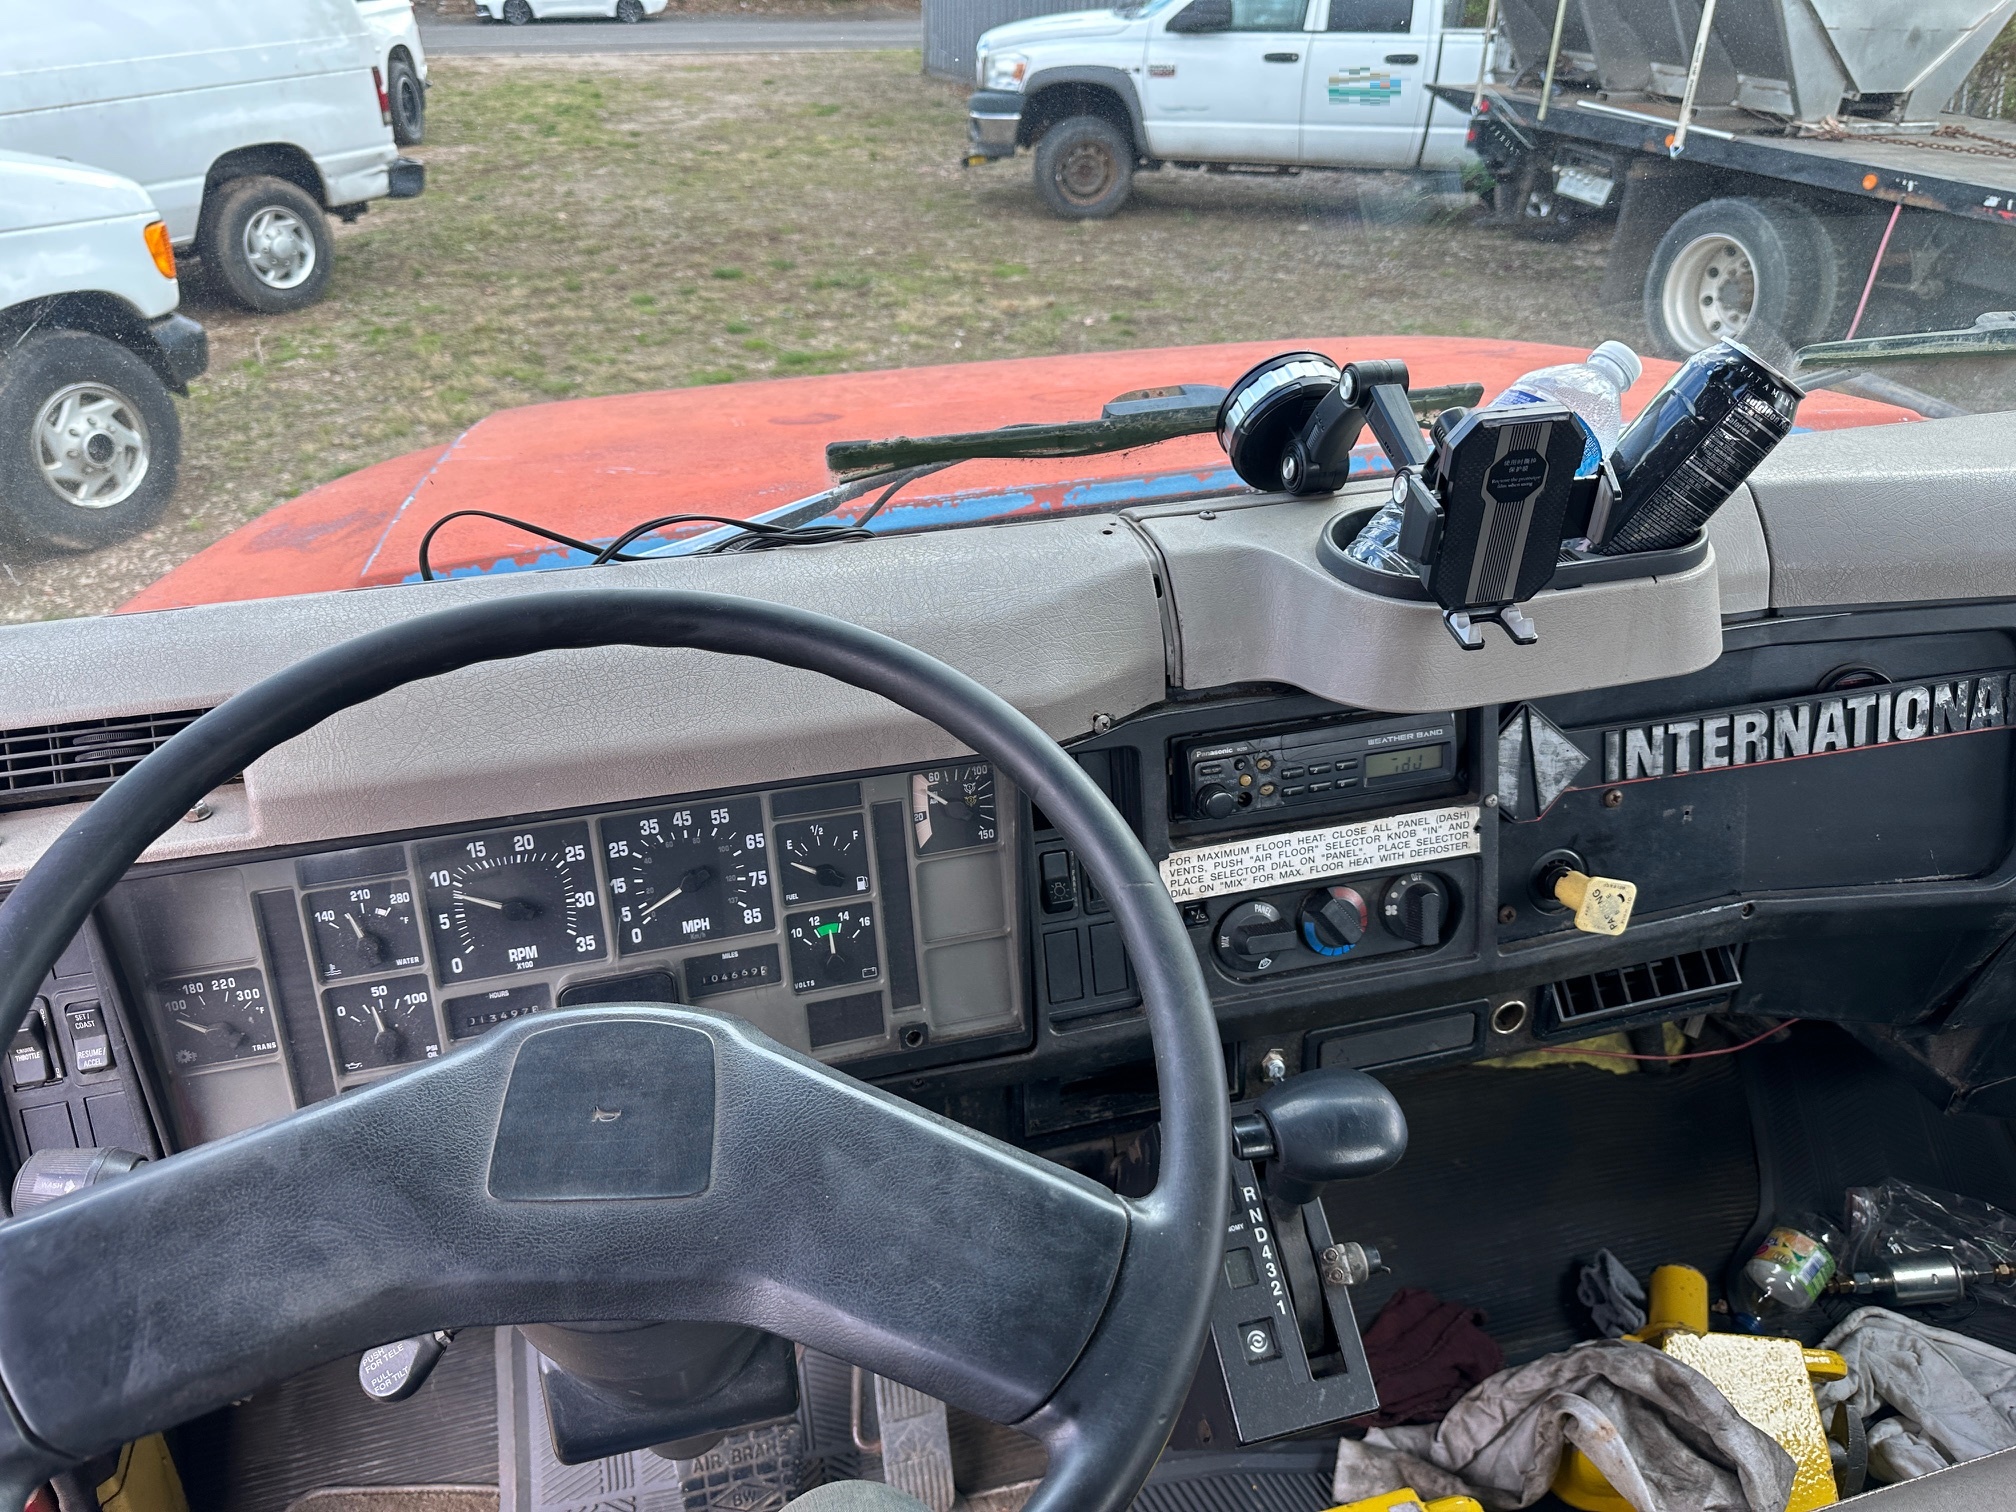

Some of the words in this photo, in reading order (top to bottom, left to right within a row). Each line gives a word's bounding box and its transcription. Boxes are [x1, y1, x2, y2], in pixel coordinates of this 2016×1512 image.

[1740, 365, 1794, 410] VITAMINS
[1742, 392, 1780, 424] Nutrition
[1725, 413, 1751, 436] Calories
[1367, 733, 1414, 745] WEATHER
[1416, 729, 1443, 739] BAND
[1196, 747, 1233, 757] Panasonic
[928, 771, 940, 782] 60
[972, 765, 988, 775] 100
[673, 810, 692, 827] 45
[710, 808, 730, 825] 55
[913, 813, 924, 822] 20
[639, 818, 659, 836] 35
[852, 830, 859, 840] F
[978, 829, 995, 840] 150
[513, 834, 535, 852] 20
[745, 833, 765, 849] 65
[786, 839, 793, 850] E
[1169, 856, 1191, 867] FOR
[1197, 846, 1250, 863] MAXIMUM
[1256, 839, 1291, 853] FLOOR
[1297, 834, 1326, 845] HEAT:
[1332, 827, 1367, 840] CLOSE
[1372, 823, 1392, 833] ALL
[1397, 817, 1430, 829] PANEL
[1435, 811, 1470, 825] (DASH)
[1213, 858, 1243, 870] PUSH
[1249, 851, 1275, 864] "AIR
[1278, 845, 1319, 859] FLOOR"
[1325, 835, 1381, 851] SELECTOR
[1387, 829, 1417, 841] KNOB
[1422, 825, 1443, 835] "IN"
[1448, 820, 1470, 831] AND
[466, 841, 486, 859] 15
[565, 845, 586, 862] 25
[608, 841, 629, 859] 25
[1170, 874, 1204, 888] PLACE
[1210, 864, 1265, 881] SELECTOR
[1271, 858, 1295, 871] DIAL
[1300, 856, 1315, 865] ON
[1377, 840, 1411, 853] PLACE
[1416, 831, 1469, 847] SELECTOR
[1170, 885, 1194, 898] DIAL
[1199, 884, 1214, 893] ON
[1219, 878, 1247, 889] "MIX"
[1252, 873, 1274, 884] FOR
[1279, 868, 1304, 880] MAX.
[1309, 858, 1344, 874] FLOOR
[1349, 855, 1375, 868] HEAT
[1379, 850, 1404, 863] WITH
[1409, 841, 1471, 858] DEFROSTER.
[1410, 873, 1423, 881] OFF
[429, 870, 450, 888] 10
[610, 877, 627, 894] 15
[748, 870, 768, 887] 75
[349, 888, 371, 901] 210
[389, 892, 410, 905] 280
[574, 891, 595, 908] 30
[785, 893, 799, 901] FUEL
[314, 910, 335, 922] 140
[621, 906, 632, 922] 5
[743, 908, 762, 925] 85
[837, 911, 850, 922] 14
[1254, 904, 1272, 917] PANEL
[1591, 888, 1618, 931] PARNG
[438, 913, 450, 930] 5
[682, 917, 710, 934] MPH
[808, 915, 821, 927] 12
[858, 917, 871, 927] 16
[631, 928, 642, 943] 0
[791, 928, 803, 939] 10
[575, 935, 596, 953] 35
[396, 956, 420, 966] WATER
[508, 945, 538, 963] RPM
[722, 951, 739, 960] MILES
[451, 957, 463, 974] 0
[516, 961, 534, 970] X100
[182, 982, 204, 994] 180
[211, 977, 236, 991] 220
[370, 985, 388, 998] 50
[794, 980, 815, 990] VOLTS
[235, 988, 260, 1001] 300
[403, 992, 428, 1005] 100
[488, 989, 509, 999] HOURS
[165, 999, 187, 1012] 100
[336, 1006, 347, 1017] 0
[74, 1020, 96, 1030] COAST
[252, 1041, 277, 1052] TRANS
[425, 1044, 438, 1052] PSI
[427, 1050, 439, 1058] OIL
[15, 1051, 41, 1062] THROTTLE
[83, 1059, 103, 1068] ACCEL
[41, 1181, 63, 1189] WASH
[1243, 1186, 1257, 1201] R
[1249, 1207, 1263, 1223] N
[1254, 1226, 1268, 1242] D
[1261, 1244, 1272, 1260] 4
[1265, 1262, 1277, 1278] 3
[1270, 1280, 1283, 1296] 2
[1276, 1299, 1287, 1315] 1
[362, 1347, 385, 1367] PUSH
[364, 1358, 383, 1374] FOR
[384, 1343, 404, 1362] TELE
[371, 1369, 394, 1387] PULL
[373, 1377, 392, 1394] FOR
[391, 1366, 409, 1383] TILT
[692, 1454, 723, 1474] AIR
[730, 1440, 789, 1465] BRAKE
